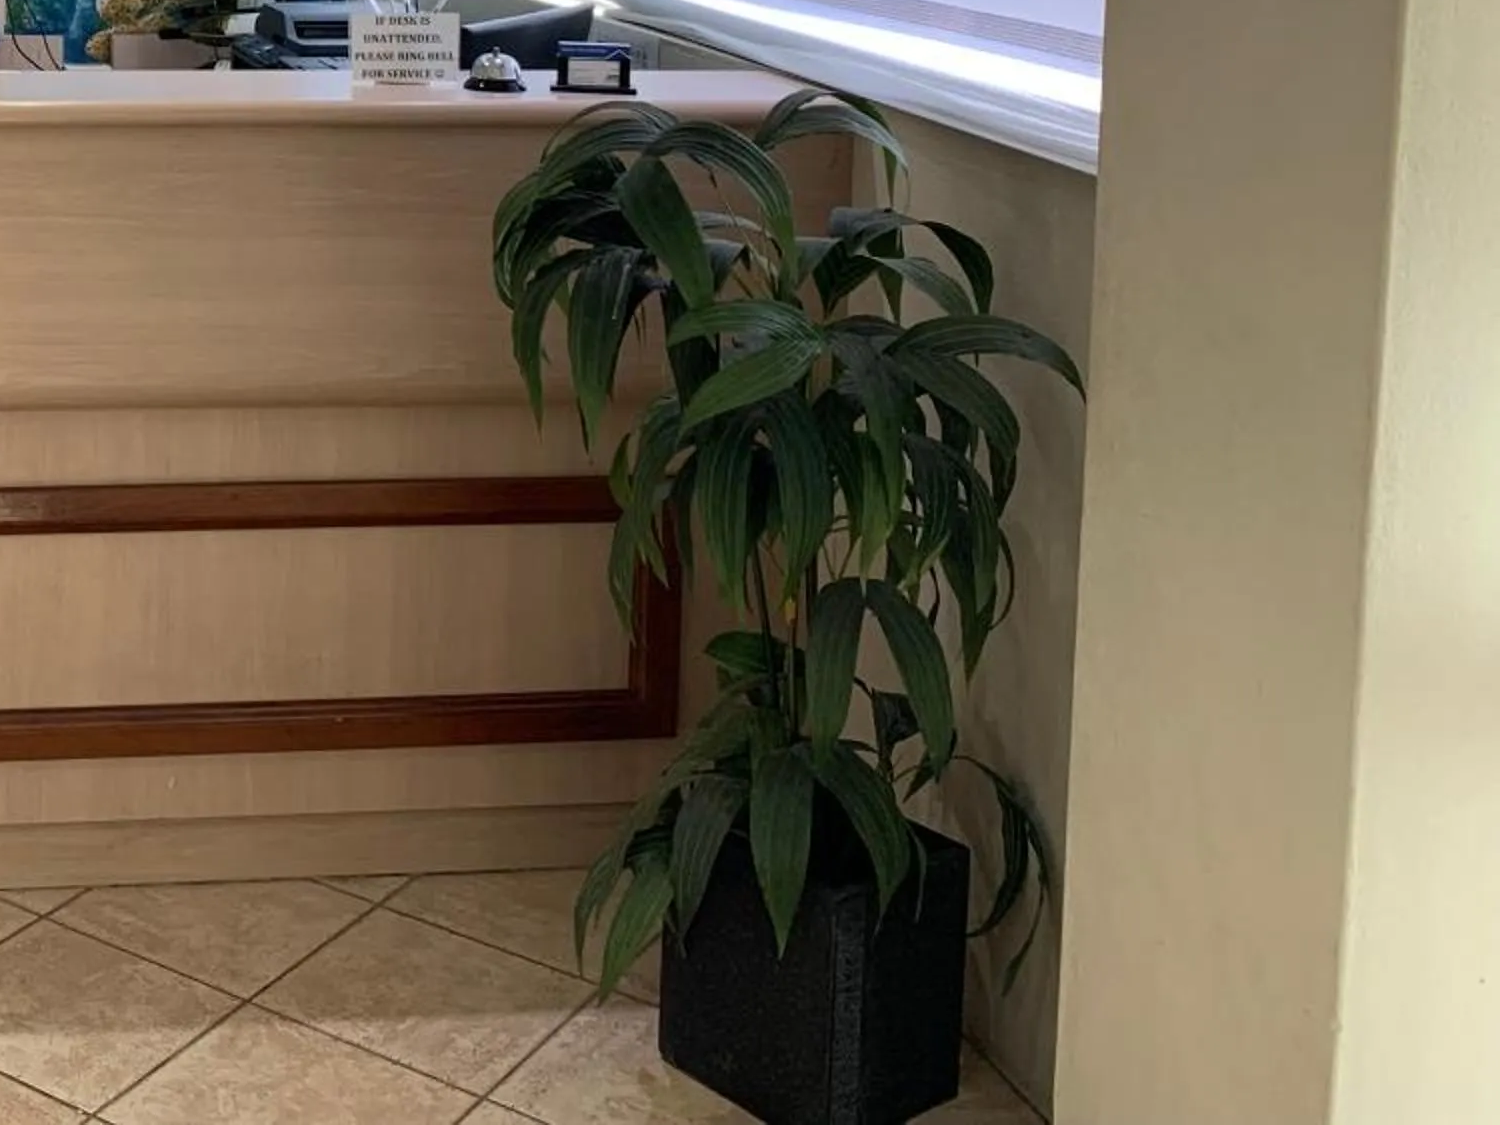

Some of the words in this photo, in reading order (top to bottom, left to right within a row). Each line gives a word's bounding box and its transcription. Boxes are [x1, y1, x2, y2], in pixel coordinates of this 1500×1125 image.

[375, 16, 386, 26] IF
[389, 16, 417, 26] DESK
[355, 51, 395, 61] PLEASE
[398, 51, 425, 61] RING
[426, 51, 454, 61] BELL
[362, 69, 385, 79] FOR
[387, 69, 430, 79] SERVICE
